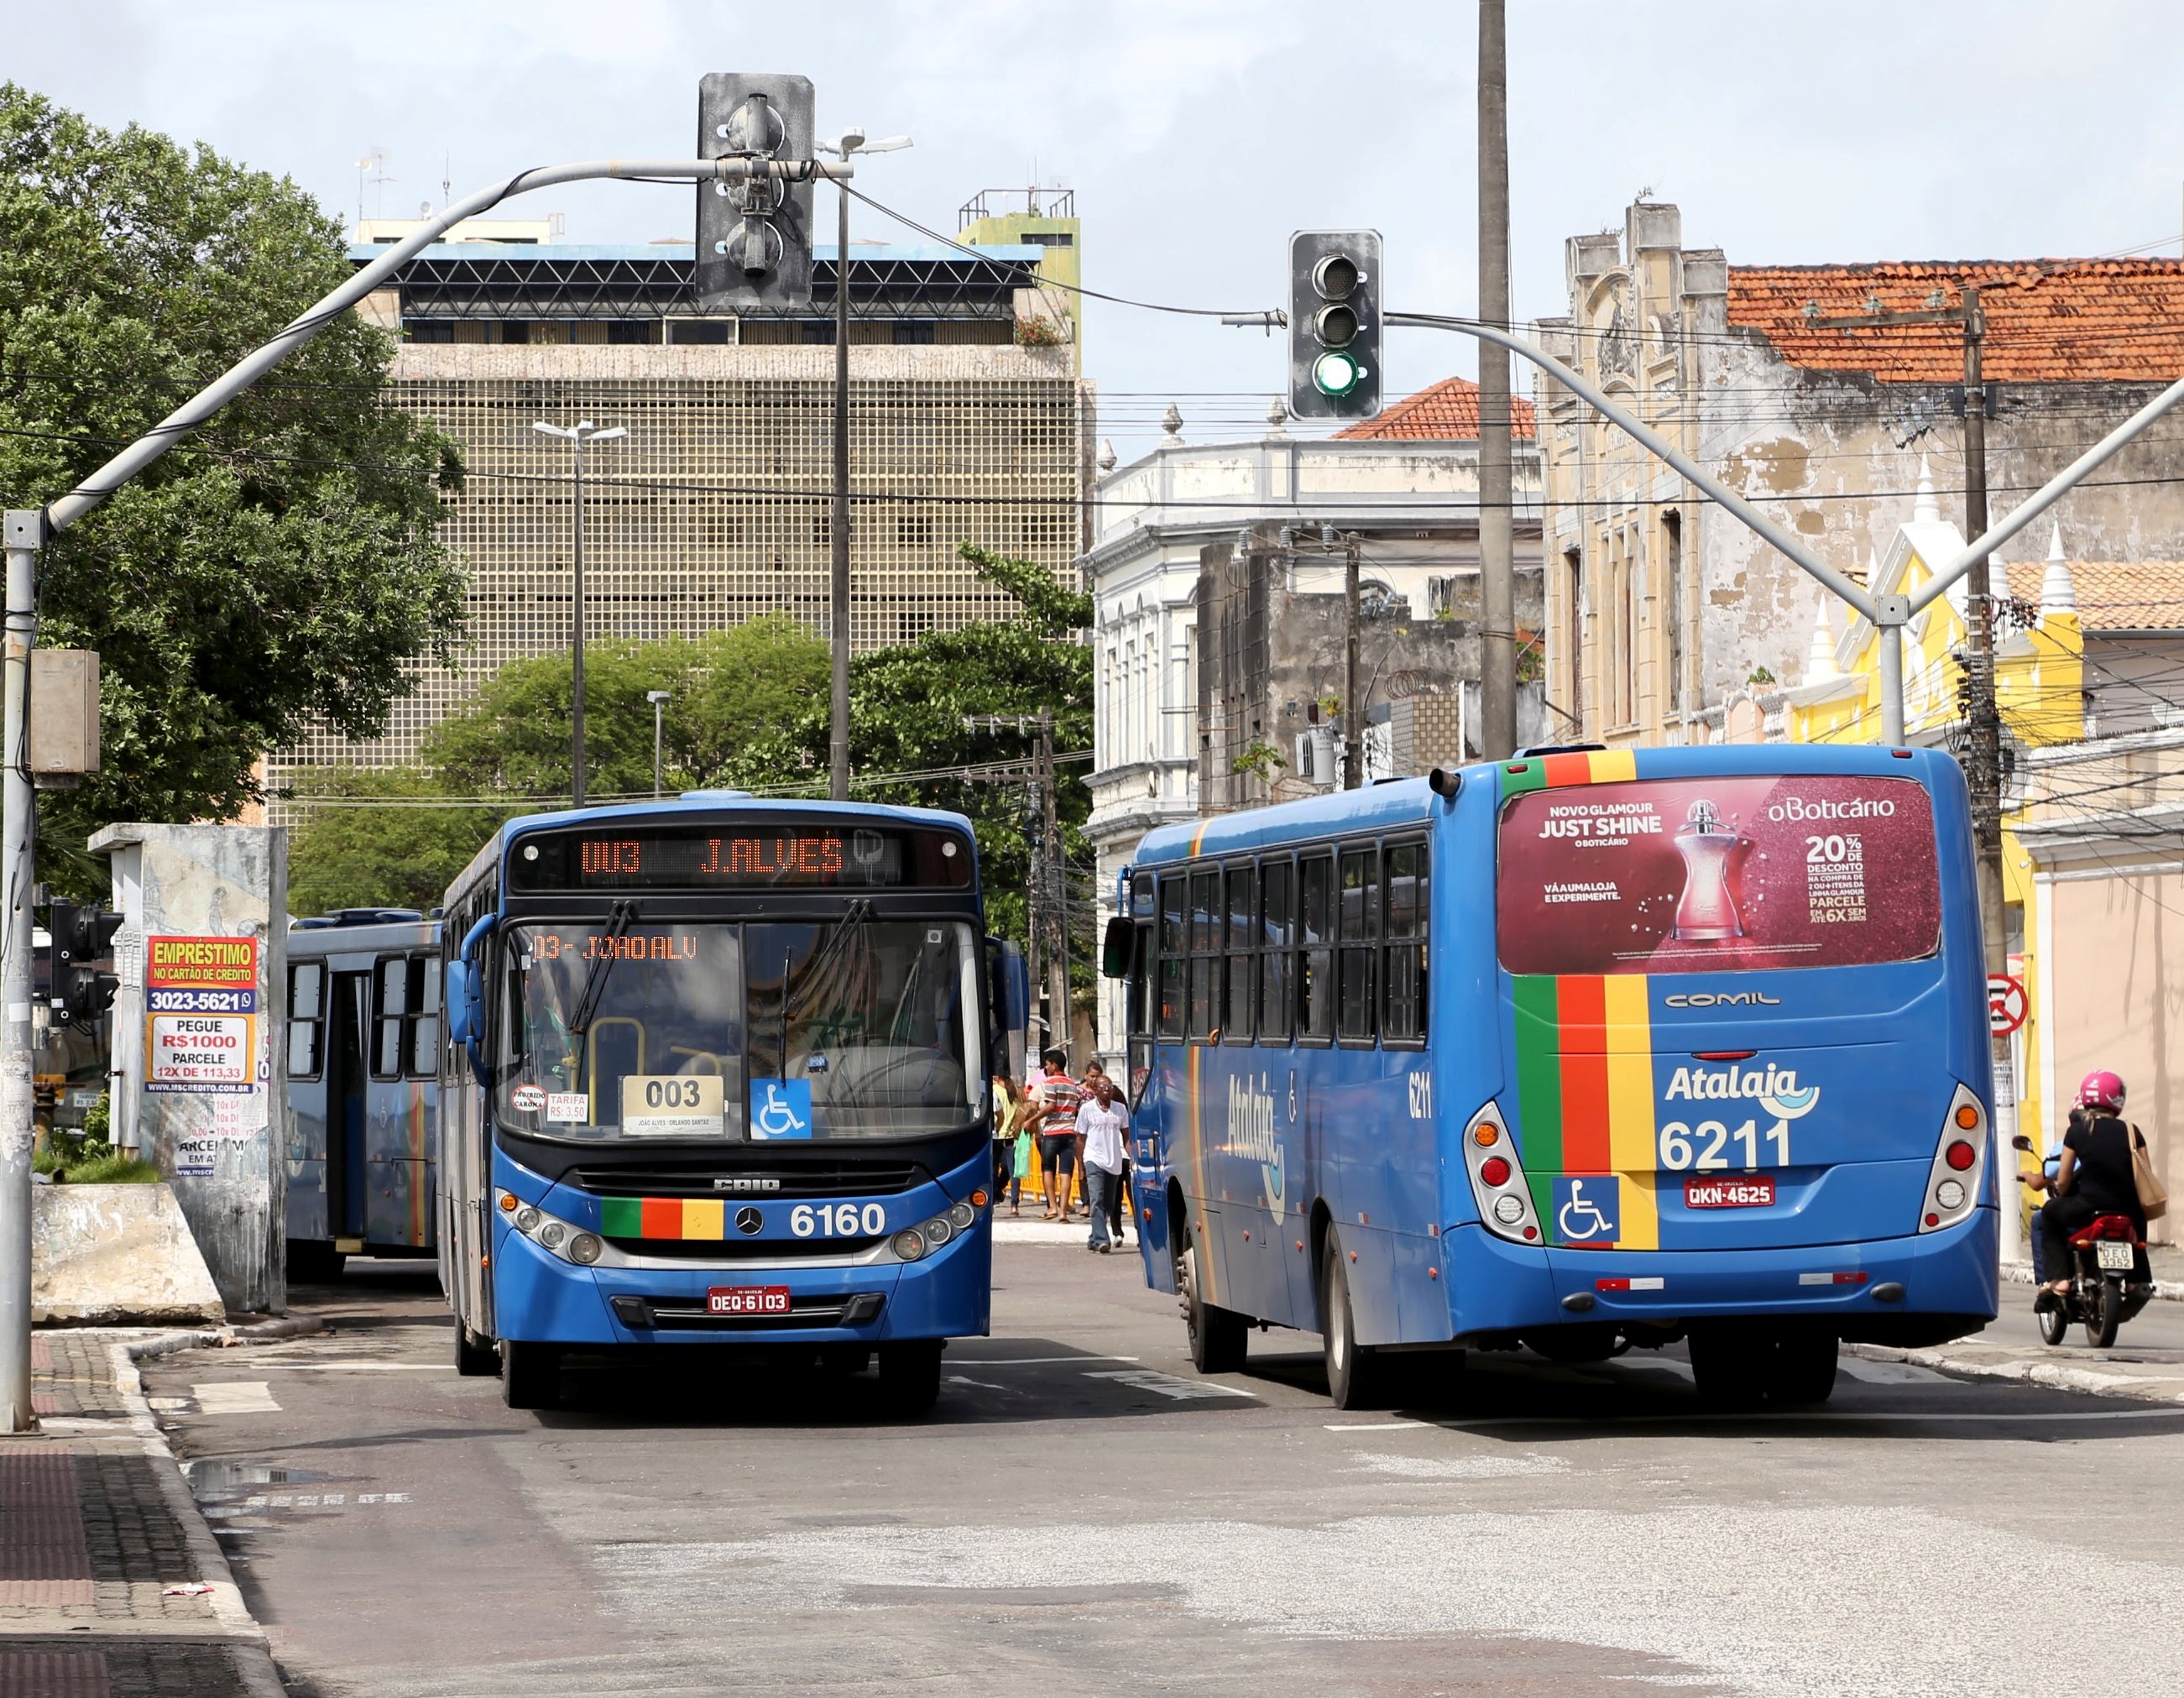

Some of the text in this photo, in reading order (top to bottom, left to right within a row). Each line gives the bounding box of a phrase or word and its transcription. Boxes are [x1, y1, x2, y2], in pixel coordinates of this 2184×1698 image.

[1549, 803, 1653, 817] NOVO GLAMOUR
[1539, 816, 1663, 839] JUST SHINE
[1583, 837, 1628, 847] BOTICÁRIO
[700, 839, 842, 873] J.ALVES
[1847, 852, 1863, 861] DE
[1807, 863, 1863, 873] DESCONTO
[1544, 881, 1617, 893] VÁ A UMA LOJA
[1544, 891, 1621, 902] E EXPERIMENTE.
[1810, 896, 1866, 908] PARCELE
[1826, 909, 1847, 922] 6X
[1847, 907, 1866, 916] SEM
[154, 938, 251, 965] EMPRÉSTIMO
[153, 965, 251, 981] NO CARTÃO DE CRÉDITO
[151, 992, 239, 1011] 3023-5621
[1664, 992, 1780, 1007] COMIL
[177, 1021, 222, 1032] PEGUE
[162, 1035, 237, 1048] R$1000
[173, 1053, 225, 1064] PARCELE
[157, 1067, 241, 1079] 12X DE 113,33
[1664, 1063, 1808, 1100] Atalaia
[148, 1083, 249, 1093] WWW.MSCREDITO.COM.BR
[645, 1079, 700, 1108] 003
[551, 1095, 585, 1105] TARIFA
[1409, 1071, 1431, 1119] 6211
[567, 1107, 584, 1119] 3,50
[1228, 1070, 1279, 1168] Atalaia
[1659, 1120, 1790, 1170] 6211
[188, 1154, 203, 1163] EM
[714, 1179, 780, 1191] CAIO
[791, 1203, 886, 1237] 6160
[2103, 1257, 2130, 1267] 3352
